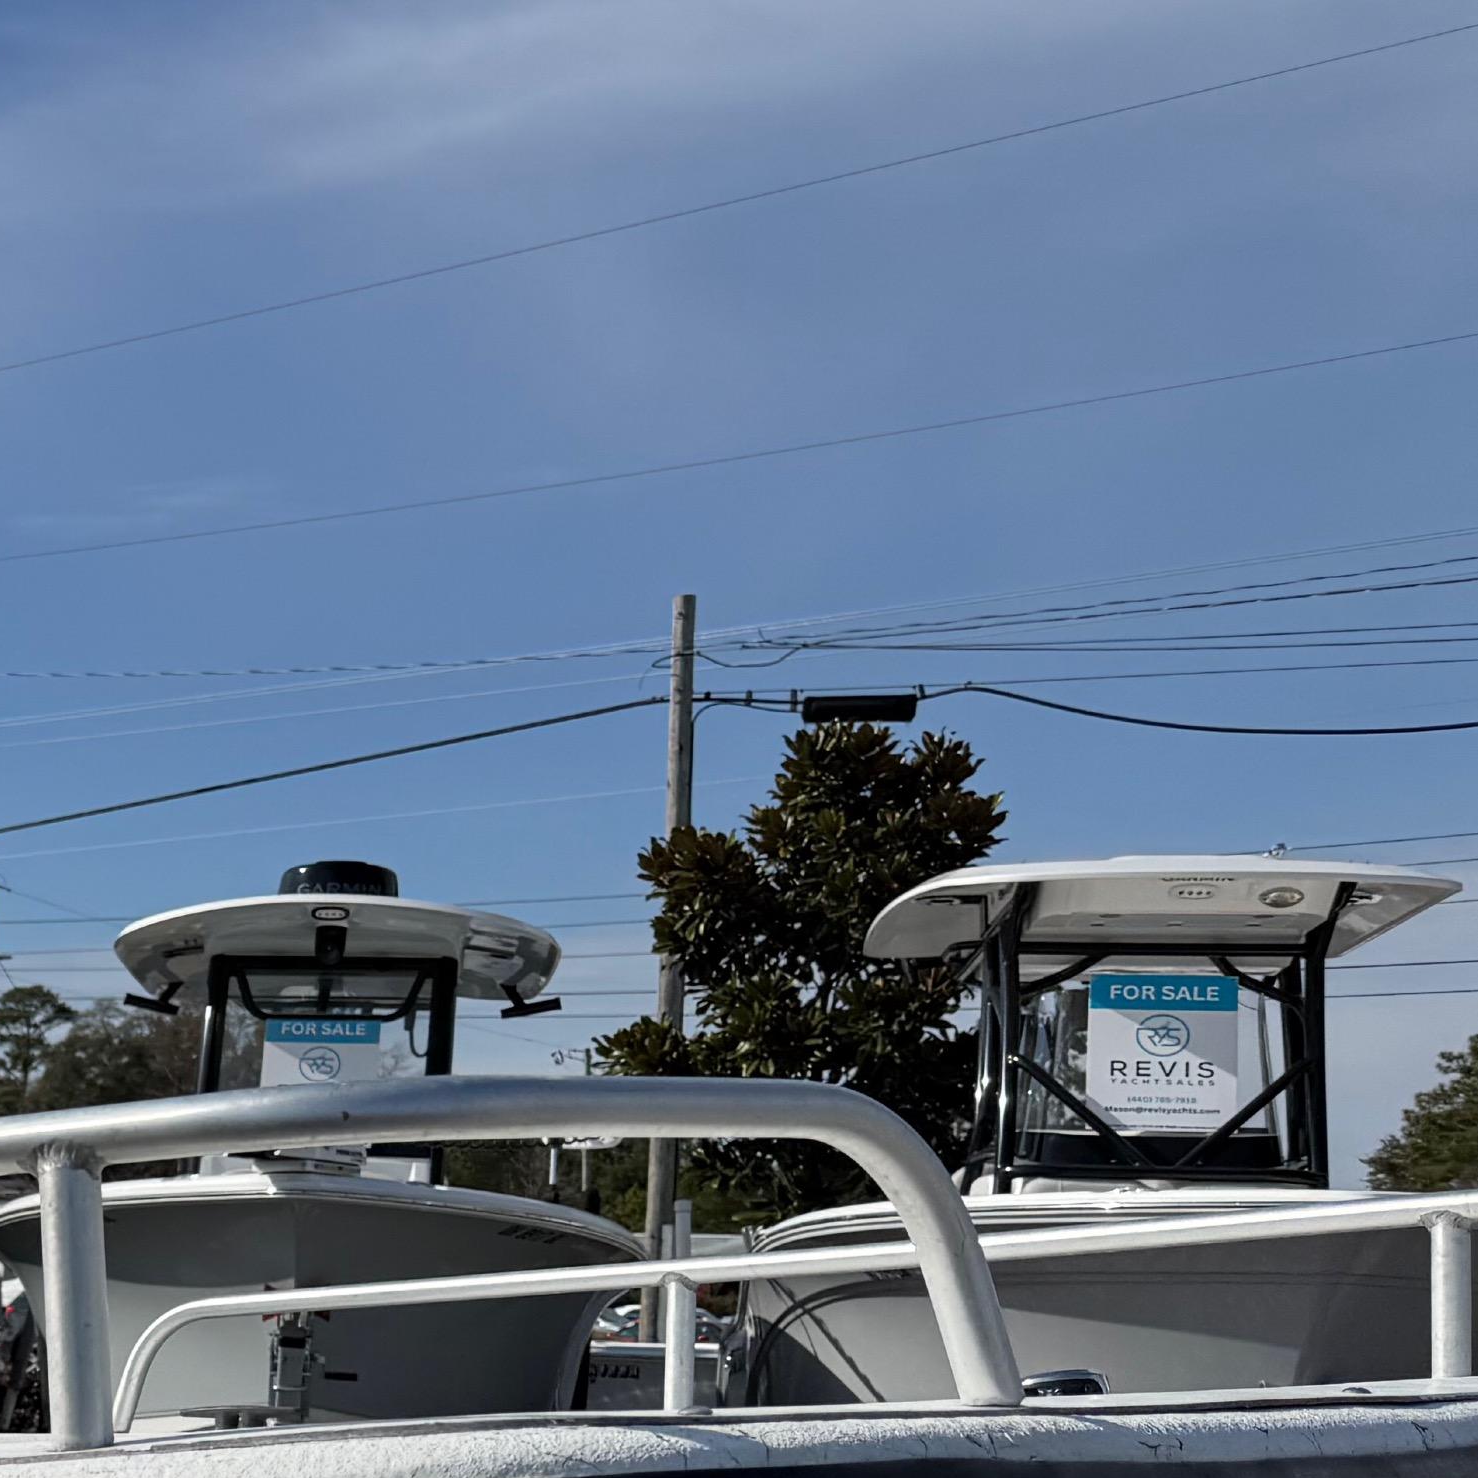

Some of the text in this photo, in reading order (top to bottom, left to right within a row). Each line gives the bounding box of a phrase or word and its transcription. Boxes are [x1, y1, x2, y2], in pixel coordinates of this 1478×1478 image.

[1109, 984, 1221, 1002] FOR SALE
[280, 1022, 367, 1037] FOR SALE
[1109, 1060, 1215, 1079] REVIS
